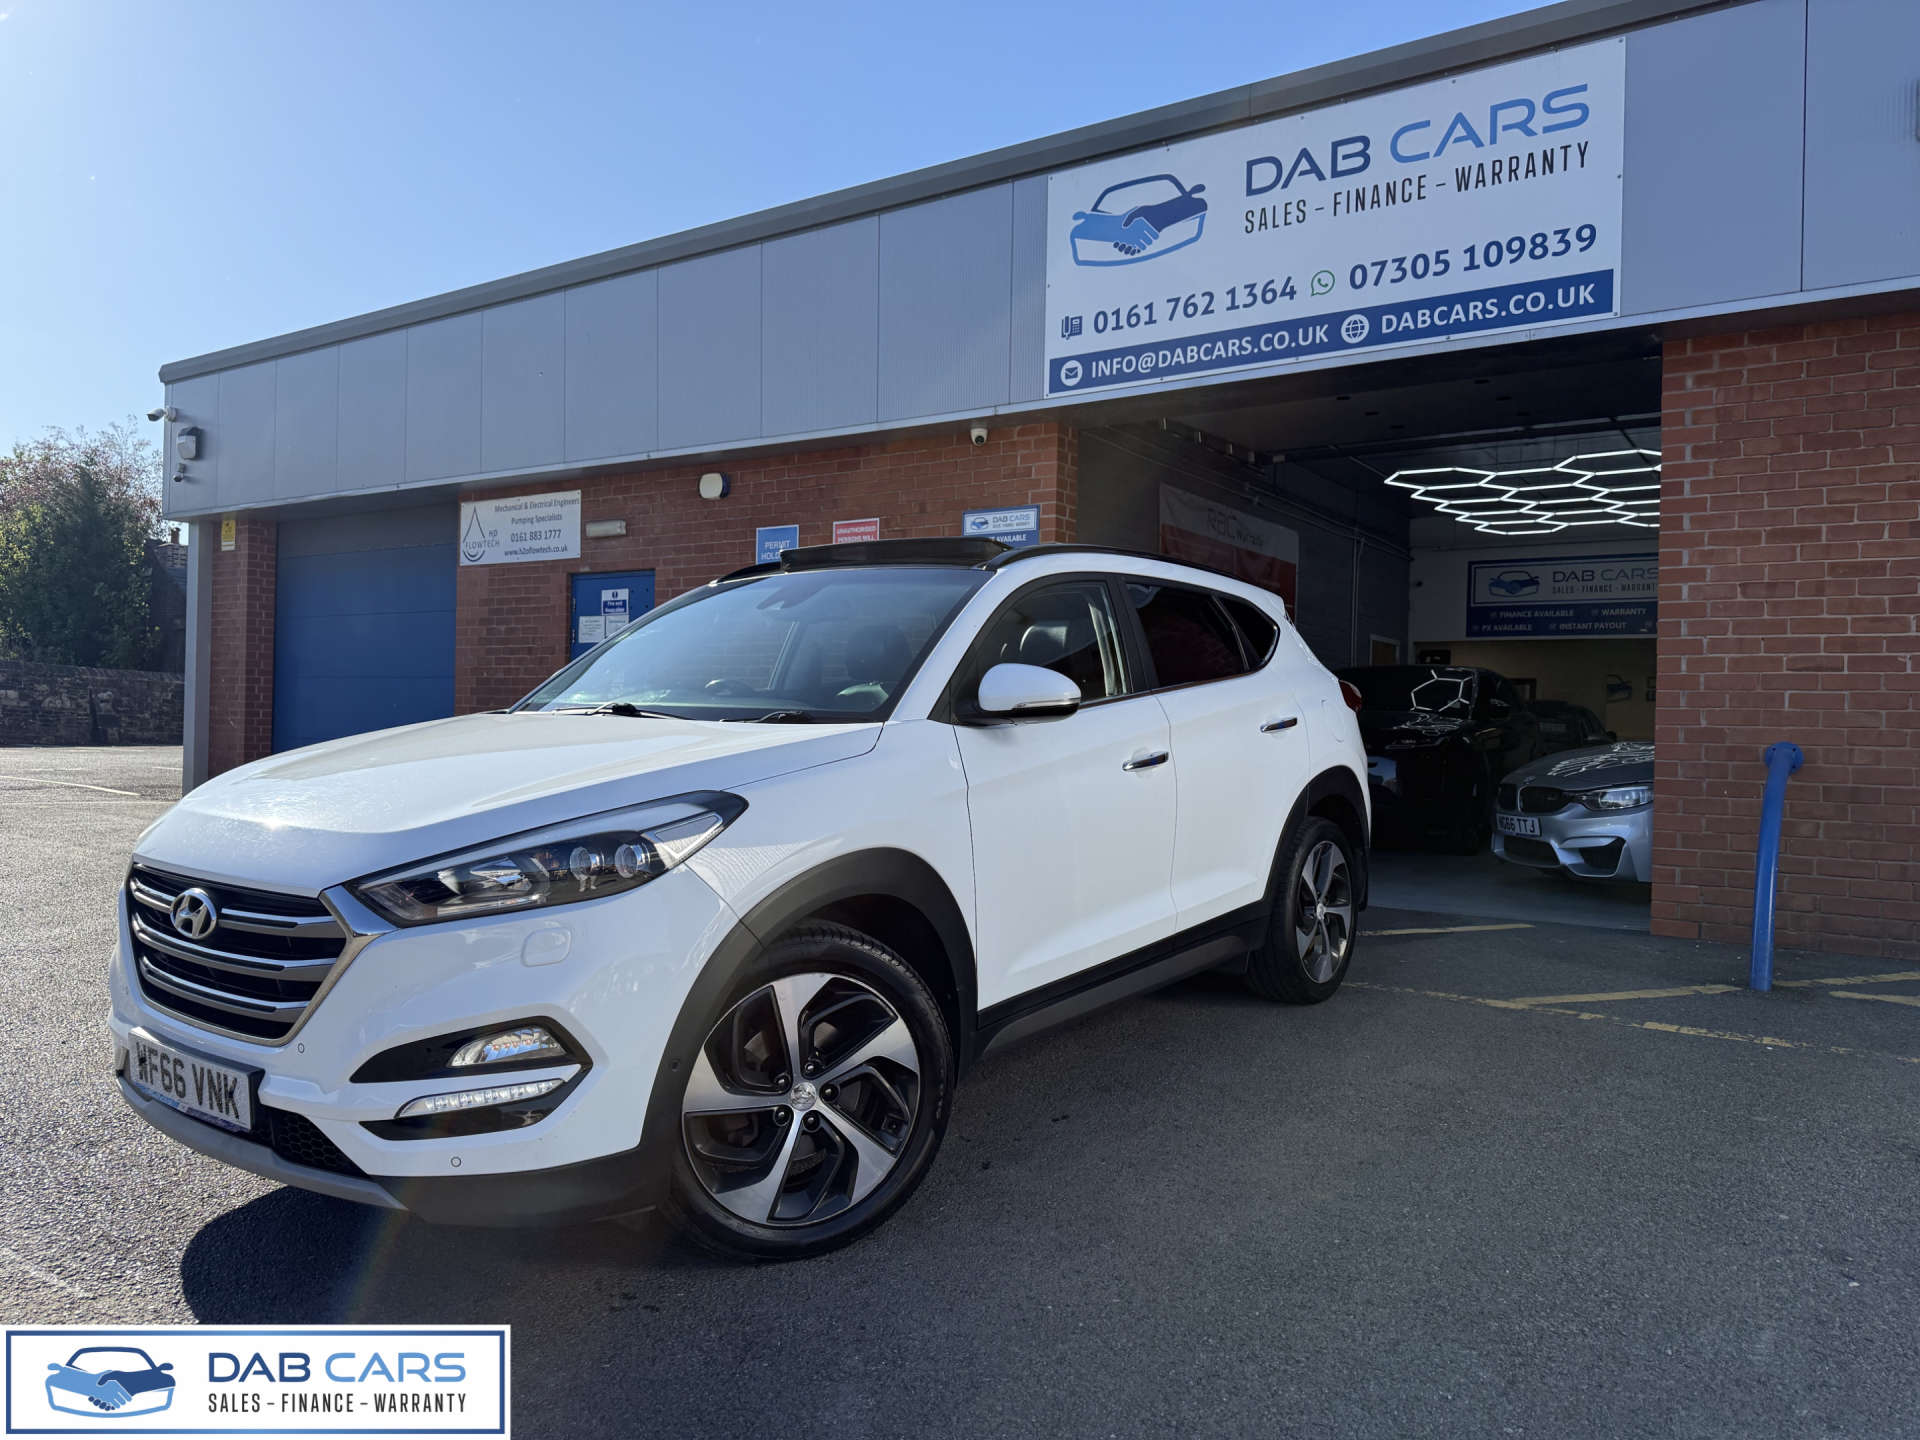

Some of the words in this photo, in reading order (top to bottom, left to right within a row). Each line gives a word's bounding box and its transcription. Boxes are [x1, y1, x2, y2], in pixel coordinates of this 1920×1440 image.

[1246, 135, 1371, 197] DAB
[1390, 83, 1590, 163] CARS
[1245, 199, 1307, 234] SALES
[1333, 174, 1427, 217] FINANCE
[1455, 141, 1590, 193] WARRANTY
[1349, 249, 1451, 290] 07305
[1463, 222, 1598, 272] 109839
[1093, 300, 1157, 334] 0161
[1167, 291, 1216, 322] 762
[1225, 276, 1297, 311] 1364
[1381, 283, 1597, 335] DABCARS.CO.UK
[1091, 324, 1329, 379] INFO@DABCARS.CO.UK
[494, 501, 523, 513] Mechanical
[512, 517, 534, 525] Pumping
[535, 513, 562, 522] Specialists
[992, 515, 1008, 523] DAB
[1009, 513, 1031, 522] CARS
[511, 532, 528, 543] 0161
[529, 530, 542, 541] 883
[544, 529, 562, 540] 1777
[996, 533, 1027, 543] AVAILABLE
[465, 539, 500, 550] FLOWTECH
[765, 540, 791, 550] PERMIT
[1552, 570, 1594, 583] DAB
[1600, 567, 1658, 581] CARS
[1621, 582, 1658, 592] WARRANT
[1534, 608, 1574, 617] AVAILABLE
[1601, 607, 1647, 616] WARRANTY
[1594, 621, 1628, 630] PAYOUT
[1516, 818, 1536, 833] TTJ
[192, 1063, 240, 1120] VNK
